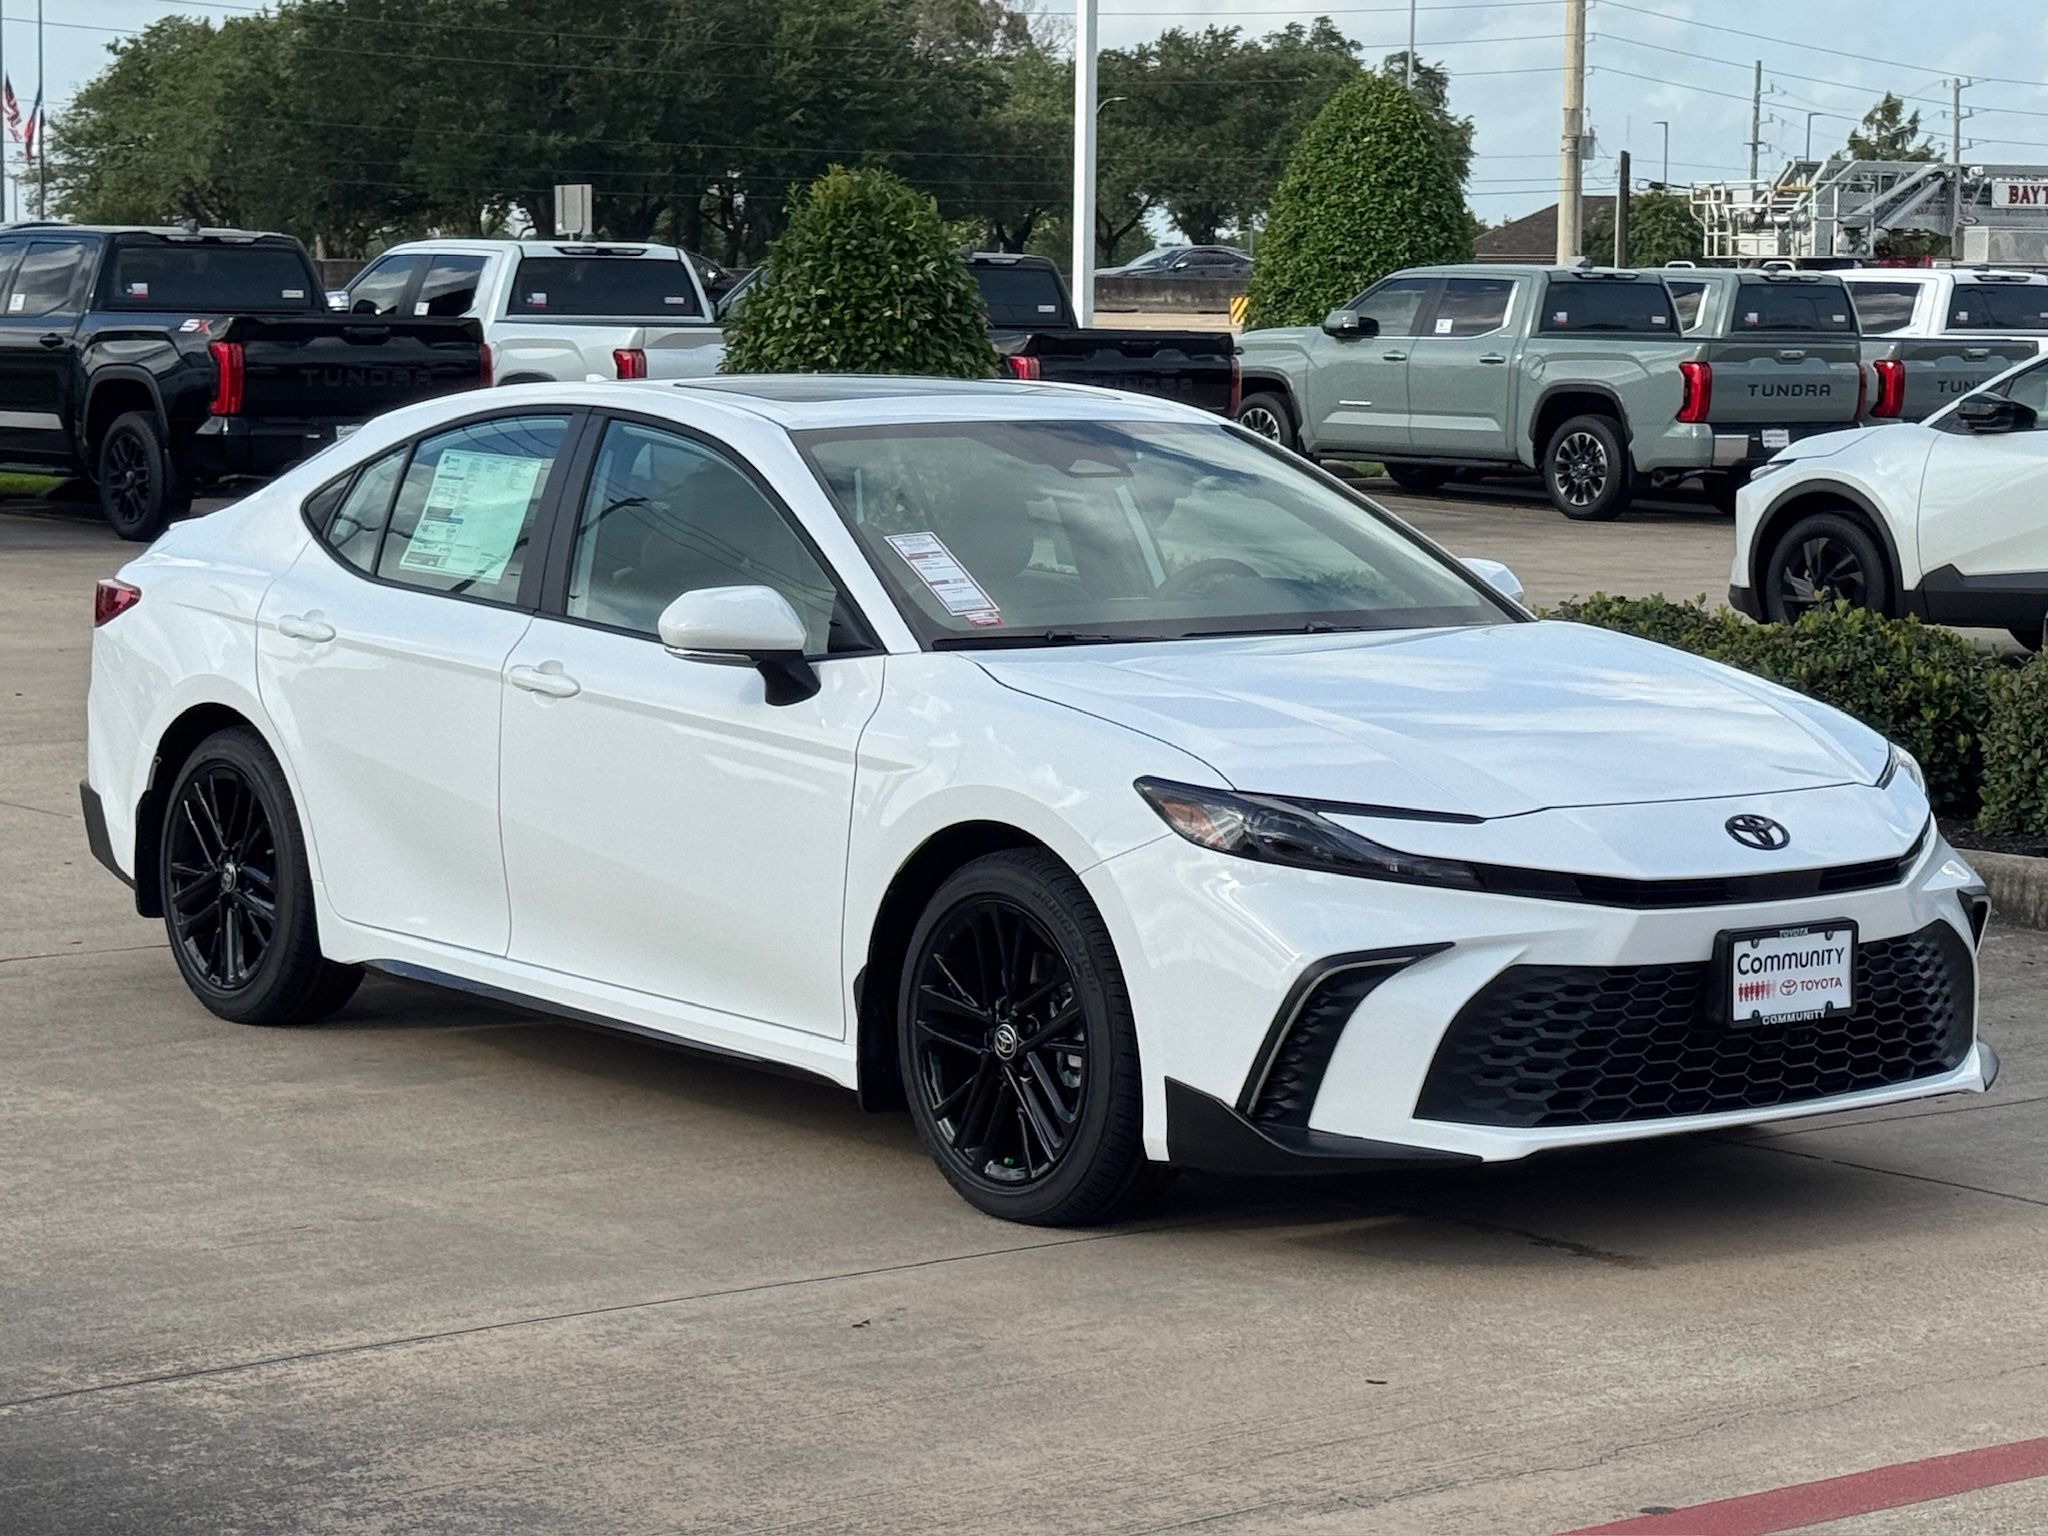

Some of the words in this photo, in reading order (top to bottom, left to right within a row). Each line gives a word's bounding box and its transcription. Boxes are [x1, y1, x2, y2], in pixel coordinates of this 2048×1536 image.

[298, 368, 433, 387] TUNDRA
[1747, 383, 1832, 397] TUNDRA
[1937, 380, 1985, 394] TUN
[1778, 927, 1809, 939] TOYOTA
[1800, 977, 1843, 992] TOYOTA
[1762, 1009, 1825, 1025] COMMUNITY
